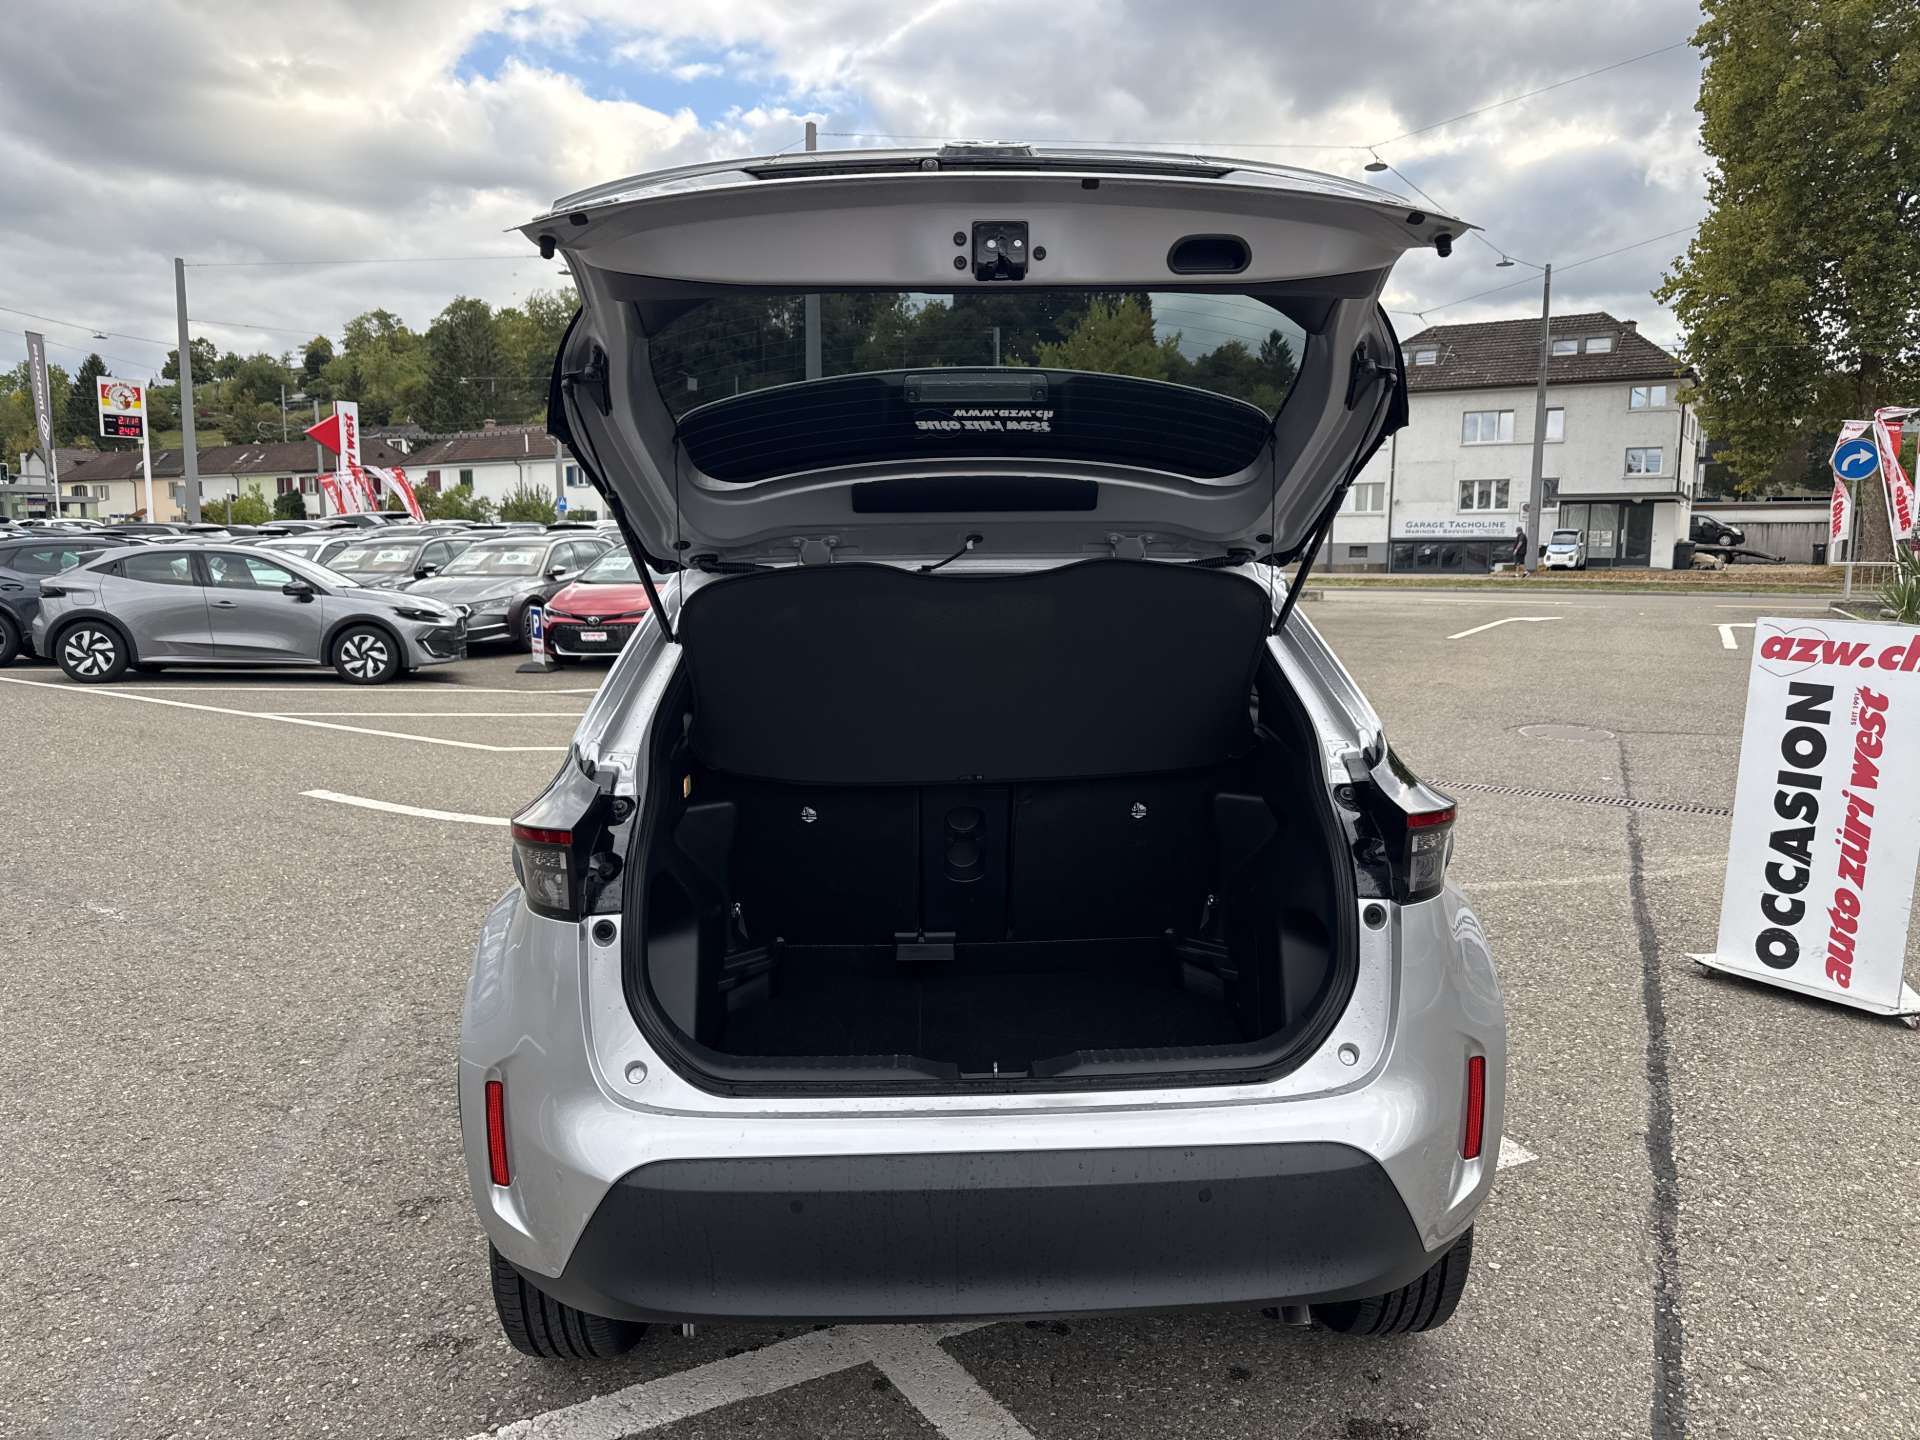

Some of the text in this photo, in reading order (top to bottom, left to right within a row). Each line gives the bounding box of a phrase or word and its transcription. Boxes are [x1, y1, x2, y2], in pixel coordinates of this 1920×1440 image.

[344, 413, 356, 450] west
[533, 614, 540, 631] P
[1850, 712, 1858, 726] SEIT
[1754, 681, 1835, 970] OCCASION
[1824, 685, 1890, 990] auto züri west
